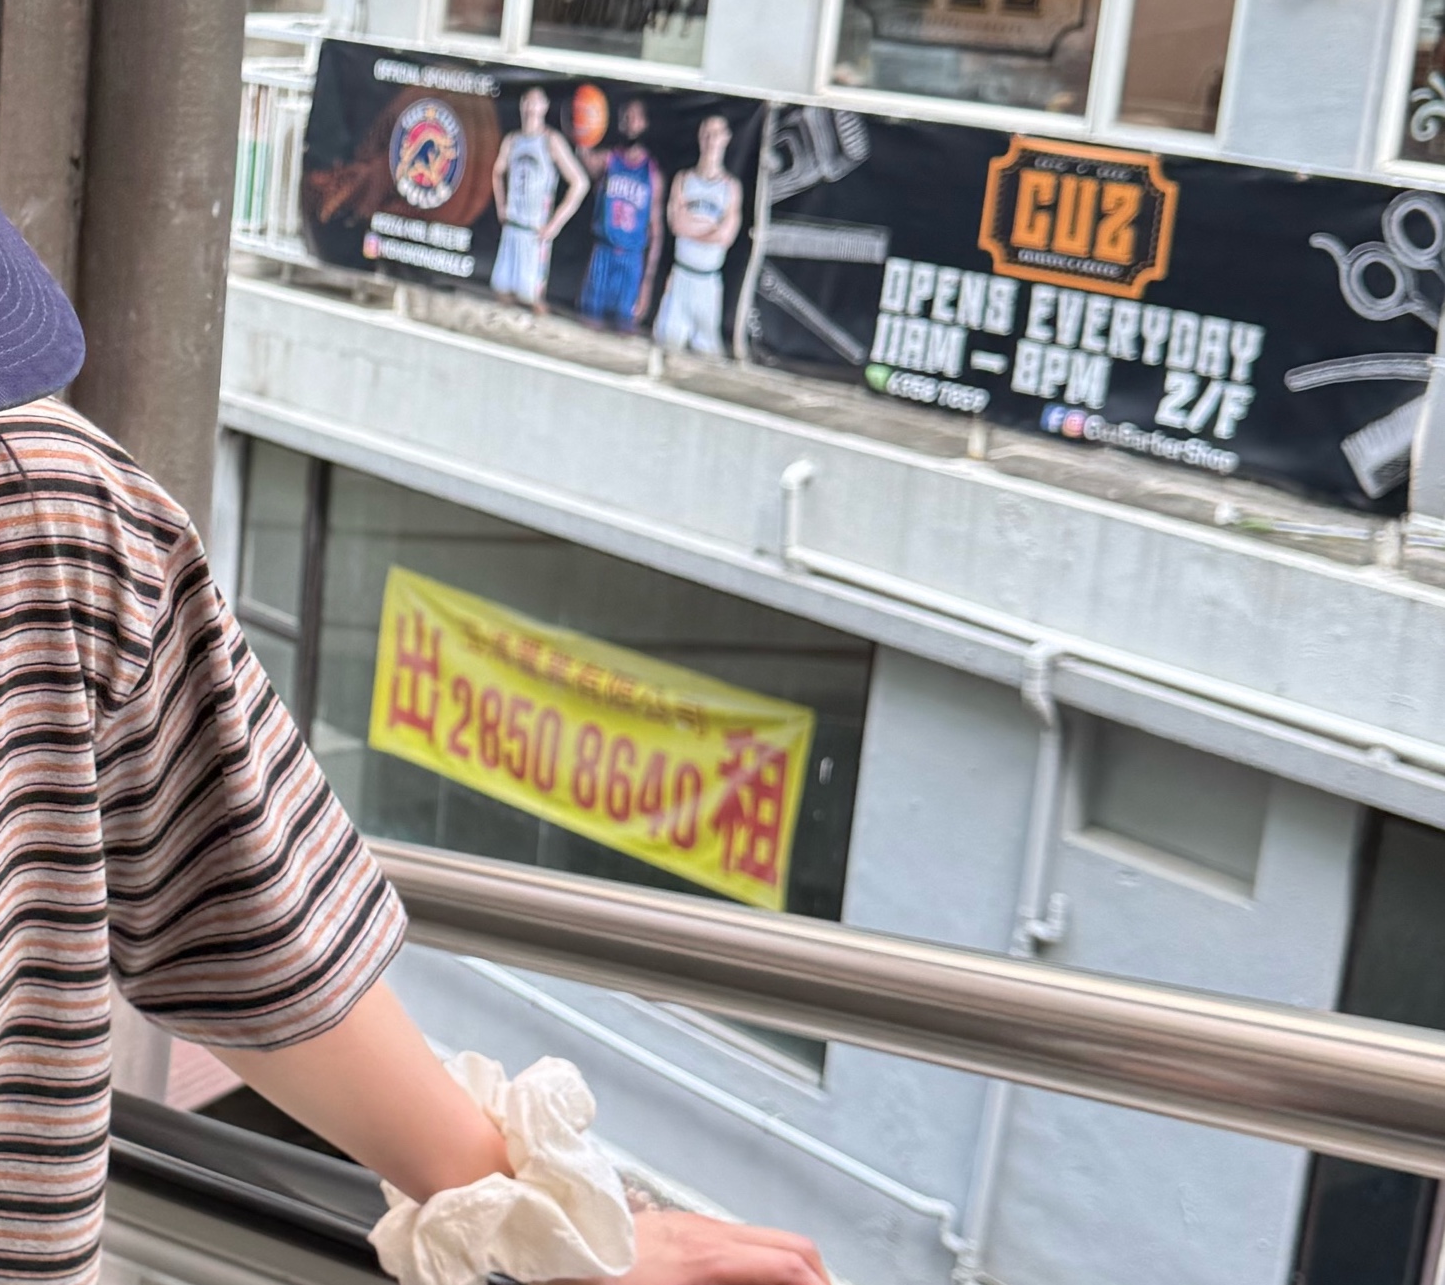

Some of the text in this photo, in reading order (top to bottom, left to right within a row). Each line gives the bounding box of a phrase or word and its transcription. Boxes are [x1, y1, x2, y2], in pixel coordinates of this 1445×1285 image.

[869, 312, 969, 379] 11AM
[1010, 337, 1113, 409] 8PM
[879, 255, 1267, 383] OPENS EVERYDAY
[386, 610, 442, 747] 出
[448, 675, 564, 795] 2850
[570, 722, 704, 852] 8640
[710, 727, 788, 887] 租
